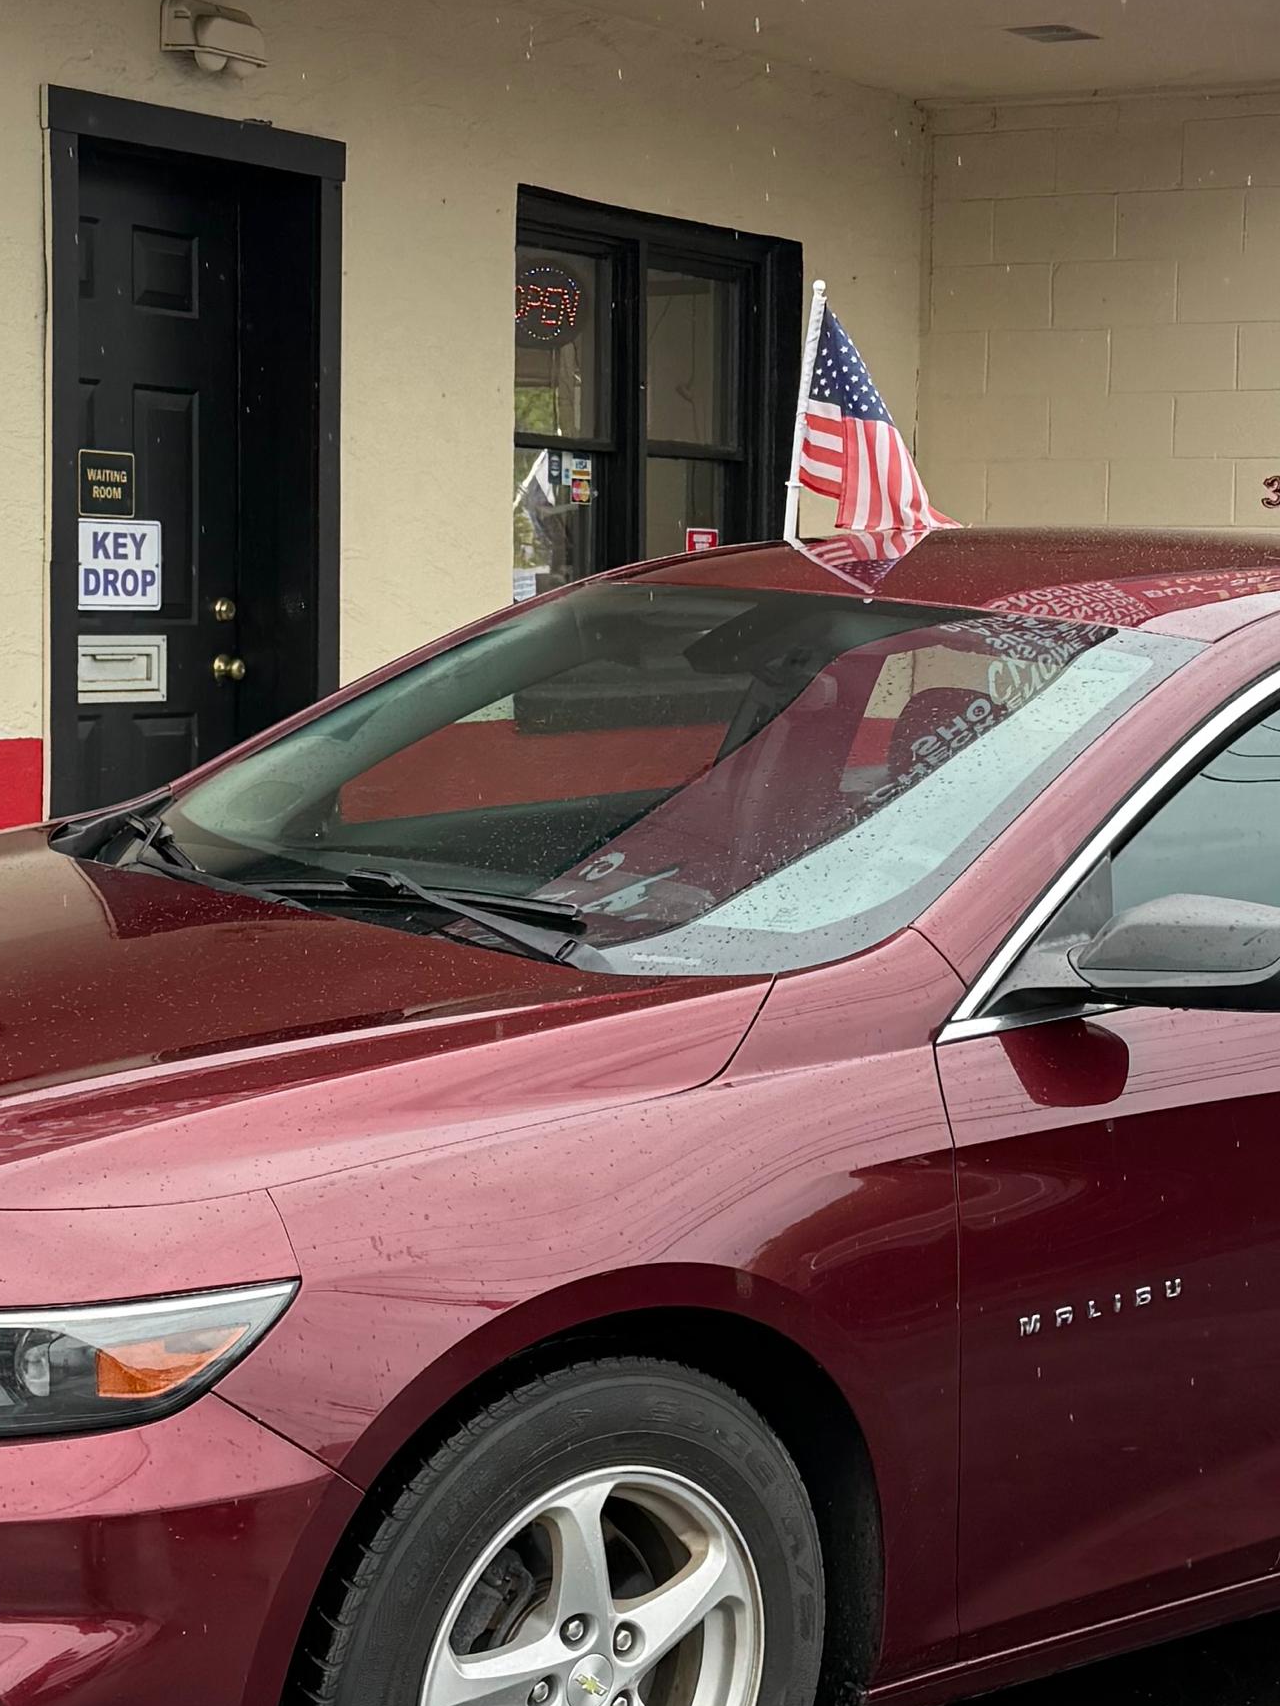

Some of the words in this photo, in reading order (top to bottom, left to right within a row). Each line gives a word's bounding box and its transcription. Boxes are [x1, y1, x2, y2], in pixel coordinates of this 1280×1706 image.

[87, 468, 127, 483] WAITING
[92, 486, 121, 500] ROOM
[92, 531, 147, 560] KEY
[83, 568, 156, 597] DROP
[1019, 1278, 1182, 1337] MALIBU
